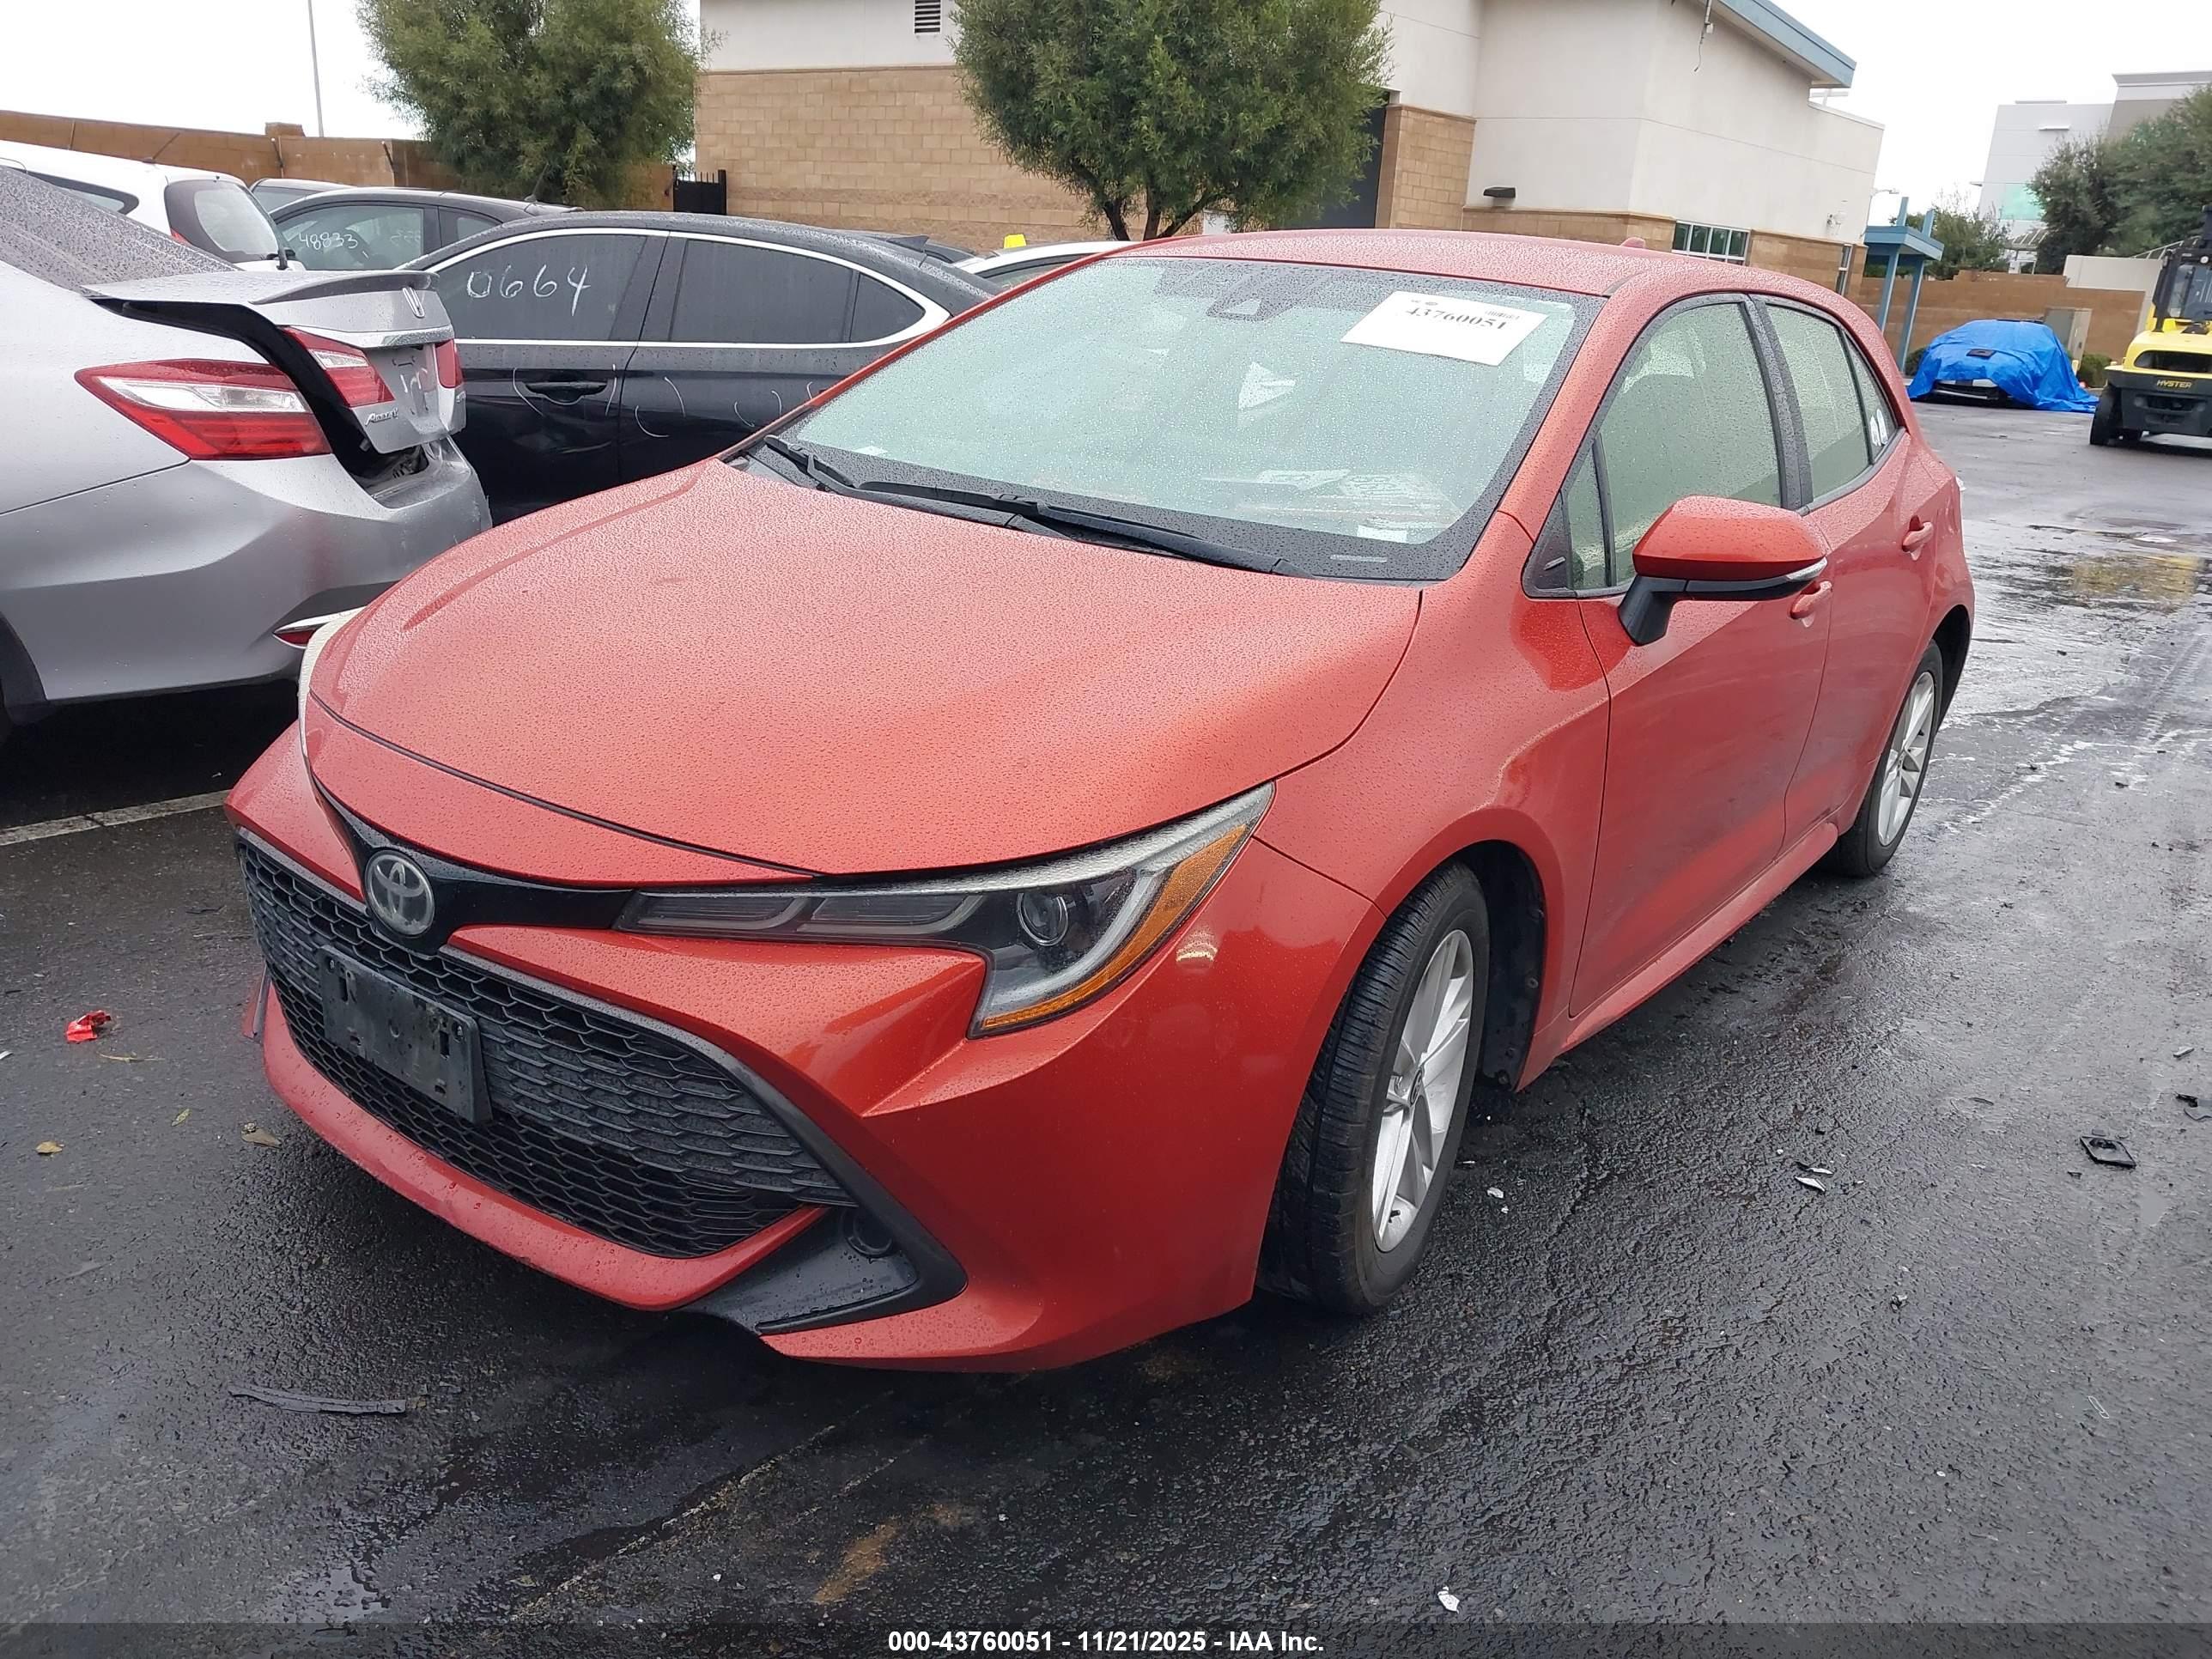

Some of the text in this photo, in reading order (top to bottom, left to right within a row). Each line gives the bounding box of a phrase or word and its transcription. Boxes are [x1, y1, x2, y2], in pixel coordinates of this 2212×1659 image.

[299, 232, 358, 251] 48833
[466, 264, 592, 317] 0664
[1405, 307, 1507, 330] 43760051
[2156, 379, 2193, 389] HYSTER
